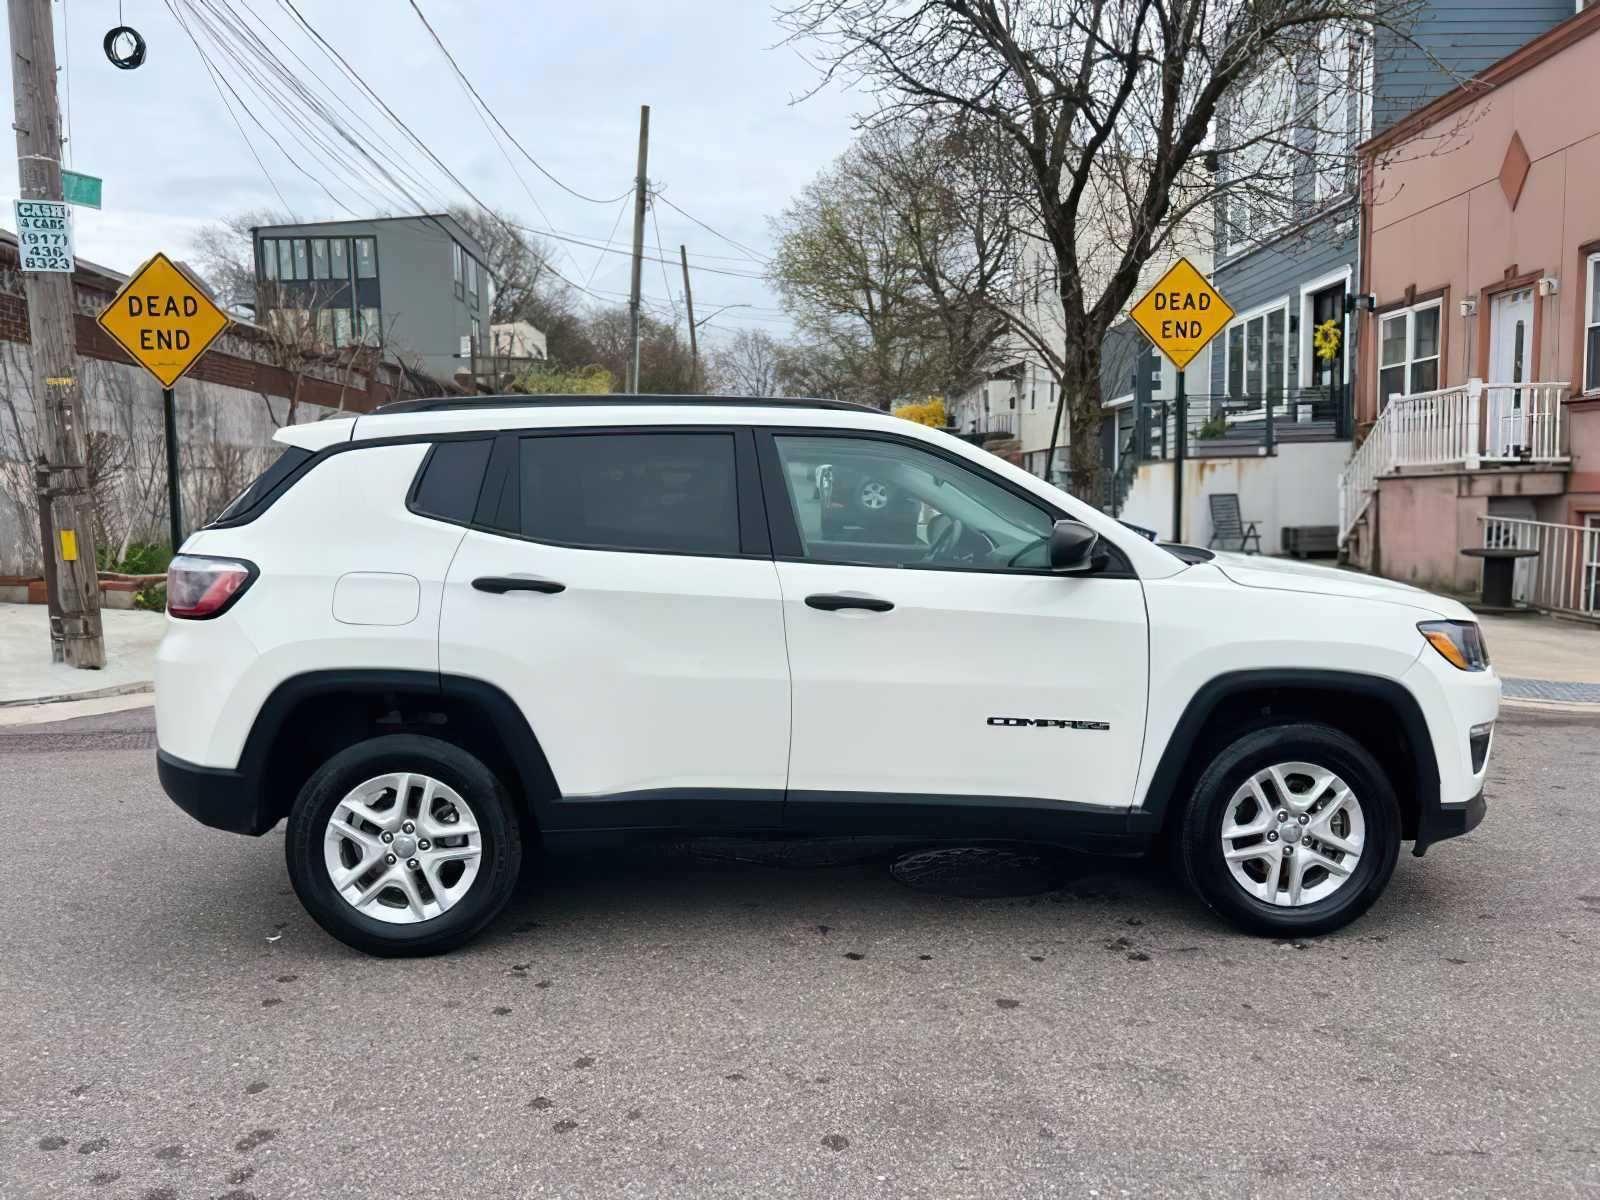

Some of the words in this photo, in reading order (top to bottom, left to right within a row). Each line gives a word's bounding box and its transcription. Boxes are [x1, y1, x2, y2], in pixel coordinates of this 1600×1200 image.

[18, 203, 68, 218] CASH
[22, 231, 68, 247] (917)
[25, 257, 70, 269] 8323
[128, 296, 198, 317] DEAD
[1154, 292, 1211, 311] DEAD
[1161, 320, 1202, 339] END
[140, 329, 190, 350] END
